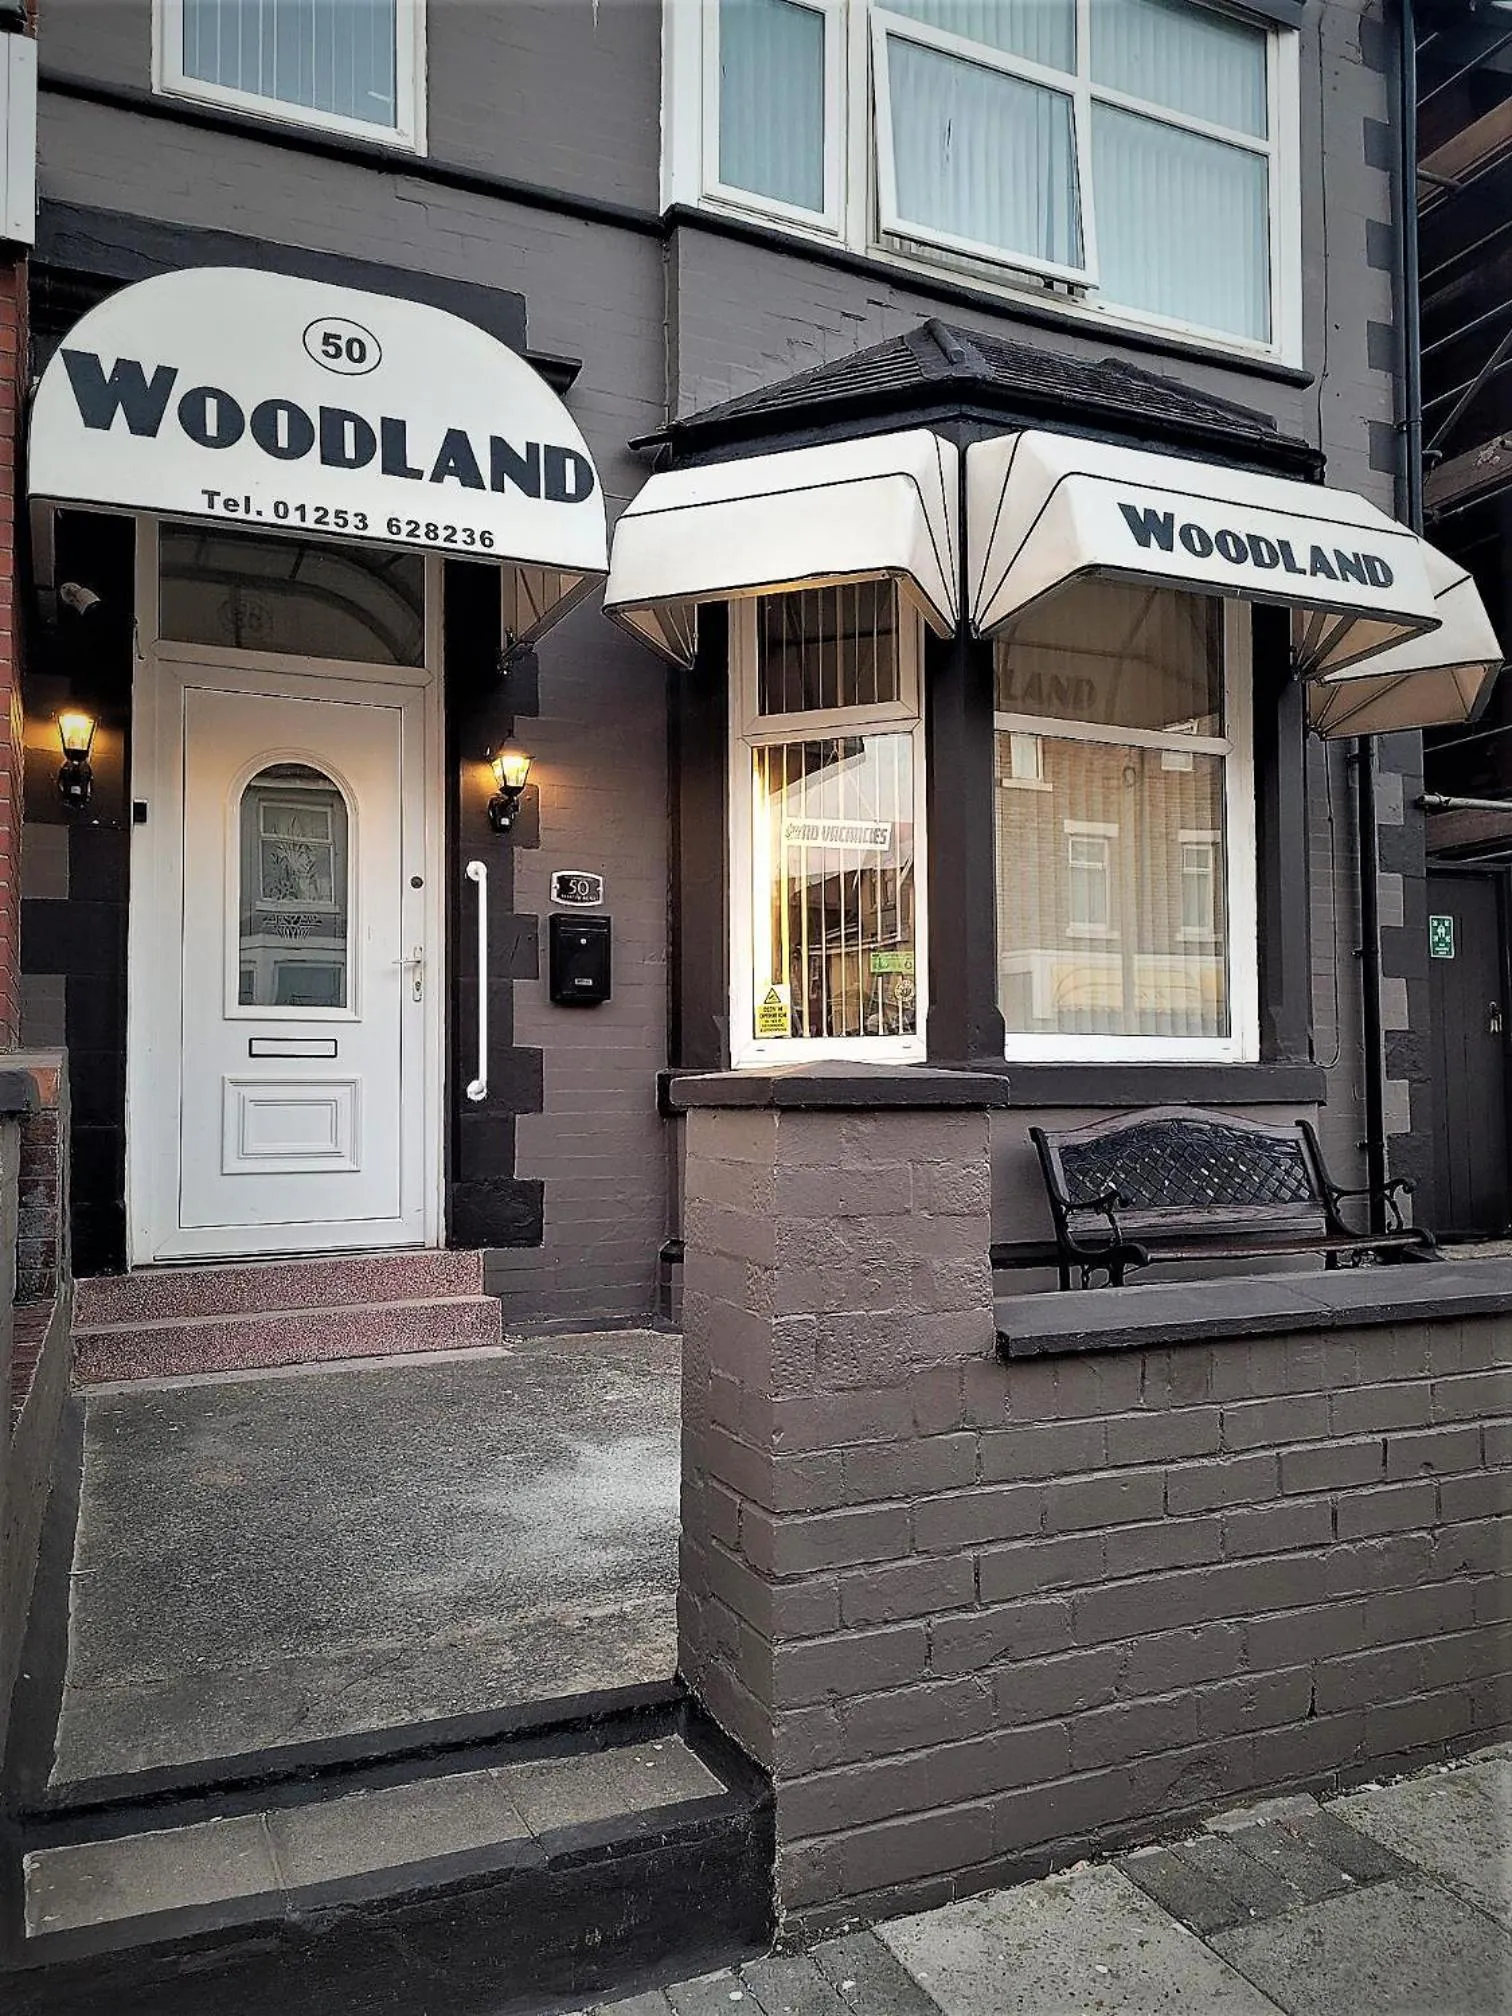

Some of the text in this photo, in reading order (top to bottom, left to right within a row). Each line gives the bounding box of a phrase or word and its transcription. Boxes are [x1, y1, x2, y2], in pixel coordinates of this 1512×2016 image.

[321, 332, 367, 365] 50
[59, 348, 595, 504] WOODLAND
[201, 488, 496, 549] Tel. 01253 628236
[1117, 502, 1394, 589] WOODLAND
[568, 879, 590, 896] 50
